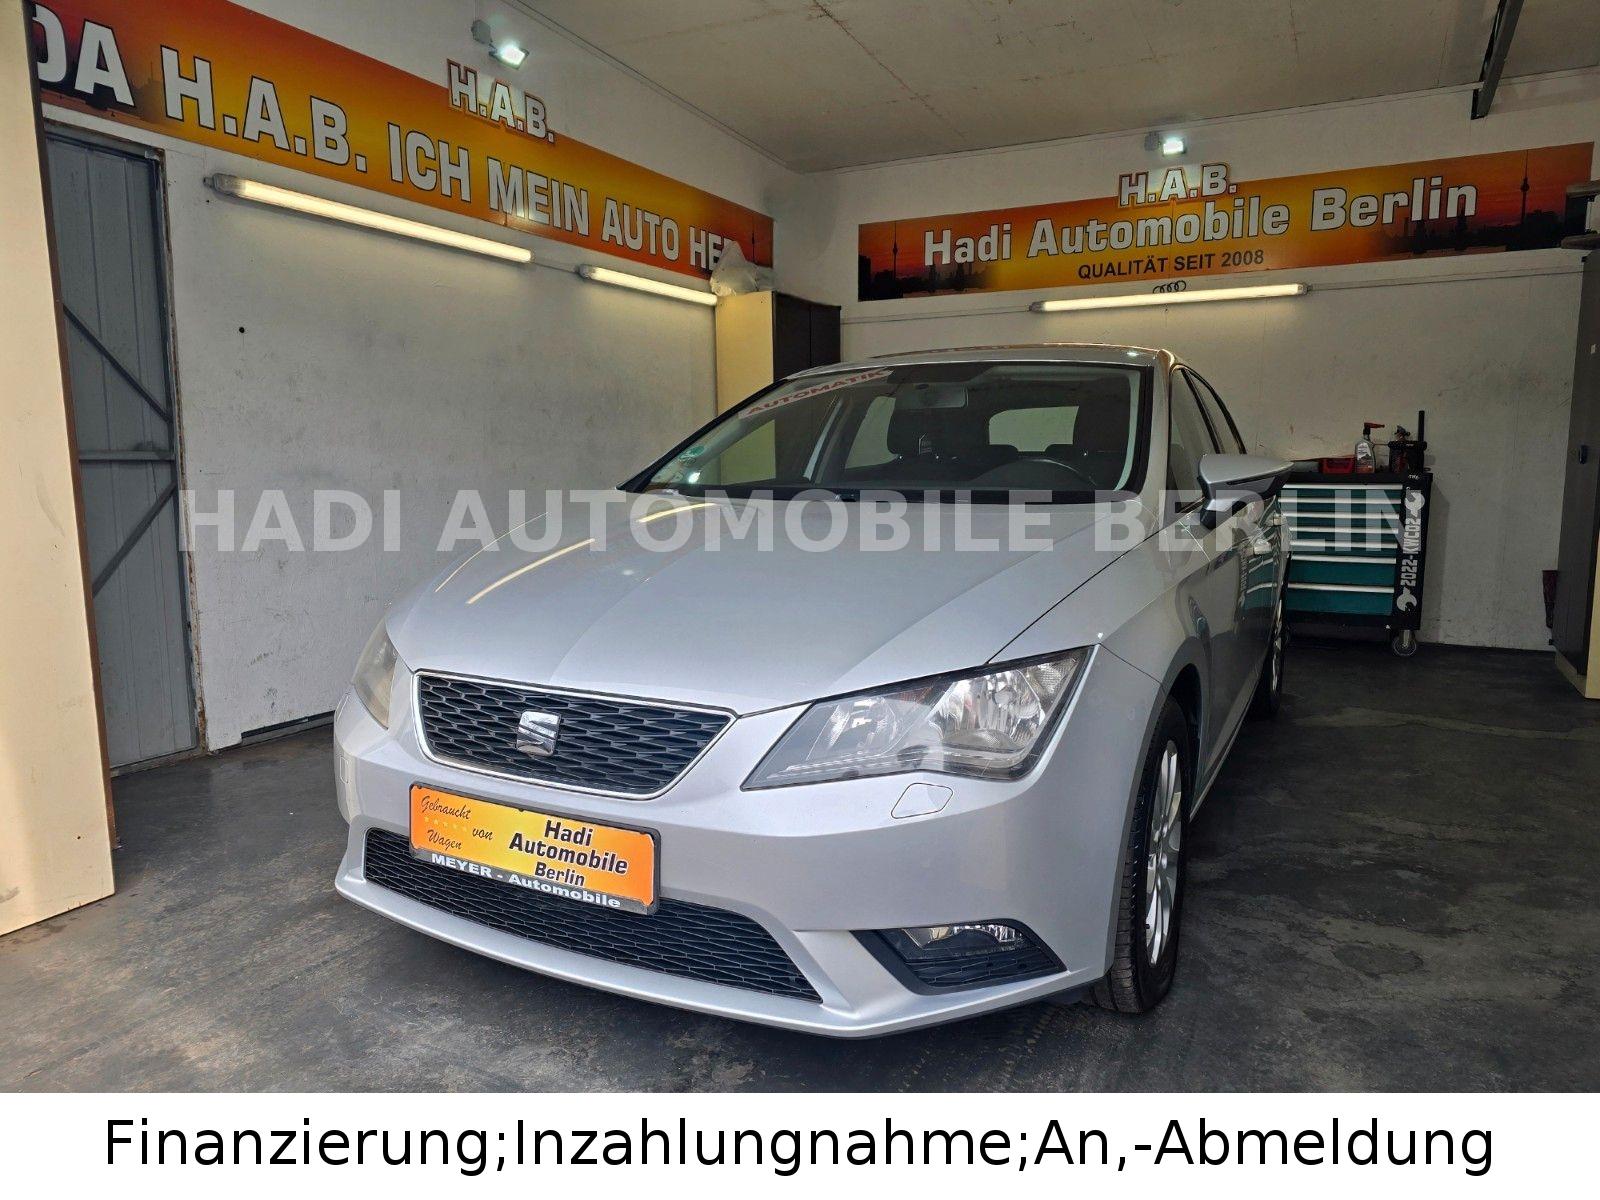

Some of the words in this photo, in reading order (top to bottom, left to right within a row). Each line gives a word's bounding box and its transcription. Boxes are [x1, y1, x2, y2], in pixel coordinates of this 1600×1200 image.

[449, 61, 555, 142] H.A.B.
[160, 44, 368, 173] H.A.B.
[387, 121, 471, 203] ICH
[487, 155, 591, 237] MEIN
[600, 197, 680, 262] AUTO
[1119, 163, 1238, 207] H.A.B.
[923, 224, 1012, 267] Hadi
[1026, 195, 1291, 259] Automobile
[1309, 177, 1479, 232] Berlin
[1078, 256, 1170, 280] QUALITÄT
[1174, 253, 1215, 273] SEIT
[1220, 249, 1265, 269] 2008
[748, 368, 884, 415] AUTOMATIK
[421, 795, 471, 820] Gebraucht
[427, 829, 462, 851] Wagen
[472, 827, 493, 841] von
[509, 832, 628, 875] Automobile
[544, 819, 593, 847] Hadi
[431, 853, 491, 878] MEYER
[509, 873, 621, 908] Automobile
[534, 861, 585, 887] Berlin
